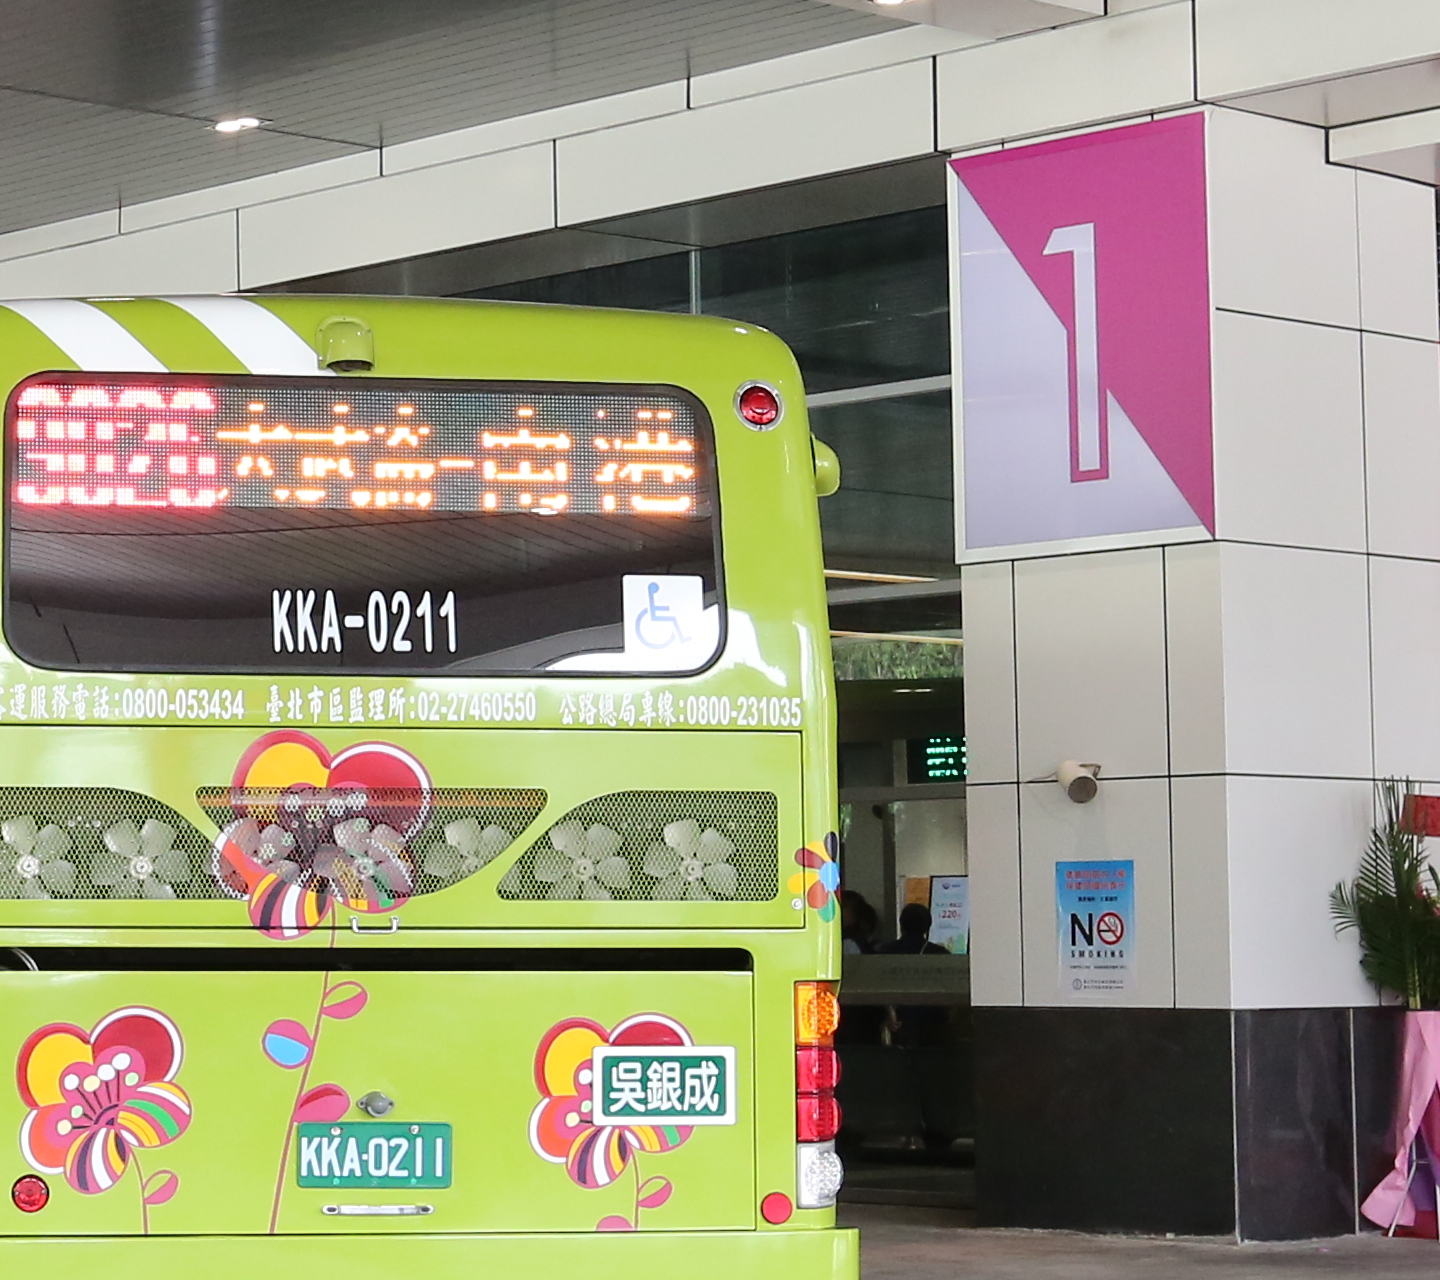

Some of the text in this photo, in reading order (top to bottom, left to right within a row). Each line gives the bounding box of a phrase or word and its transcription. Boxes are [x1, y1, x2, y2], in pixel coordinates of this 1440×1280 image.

[1041, 222, 1102, 473] 1
[271, 589, 459, 654] KKA-0211
[1071, 950, 1124, 959] SMOKING
[608, 1060, 720, 1113] 吳銀成
